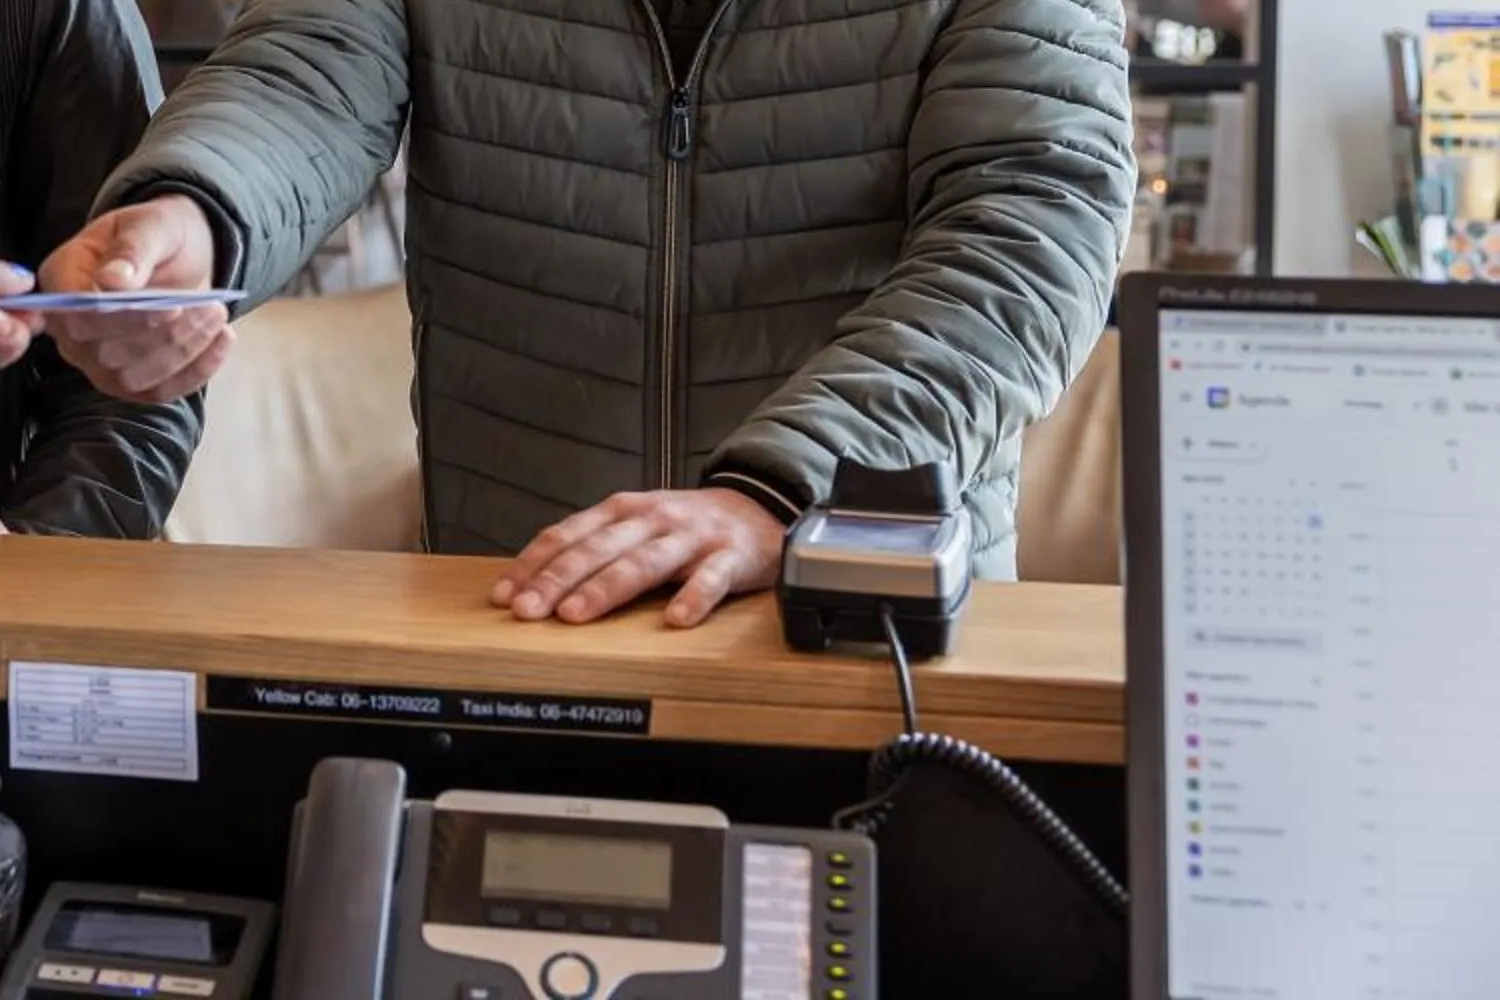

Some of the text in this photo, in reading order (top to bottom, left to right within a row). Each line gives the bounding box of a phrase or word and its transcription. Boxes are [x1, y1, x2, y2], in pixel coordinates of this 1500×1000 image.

[255, 687, 301, 704] Yellow
[304, 690, 337, 707] Cab:
[461, 698, 493, 715] Taxi
[497, 701, 536, 719] India:
